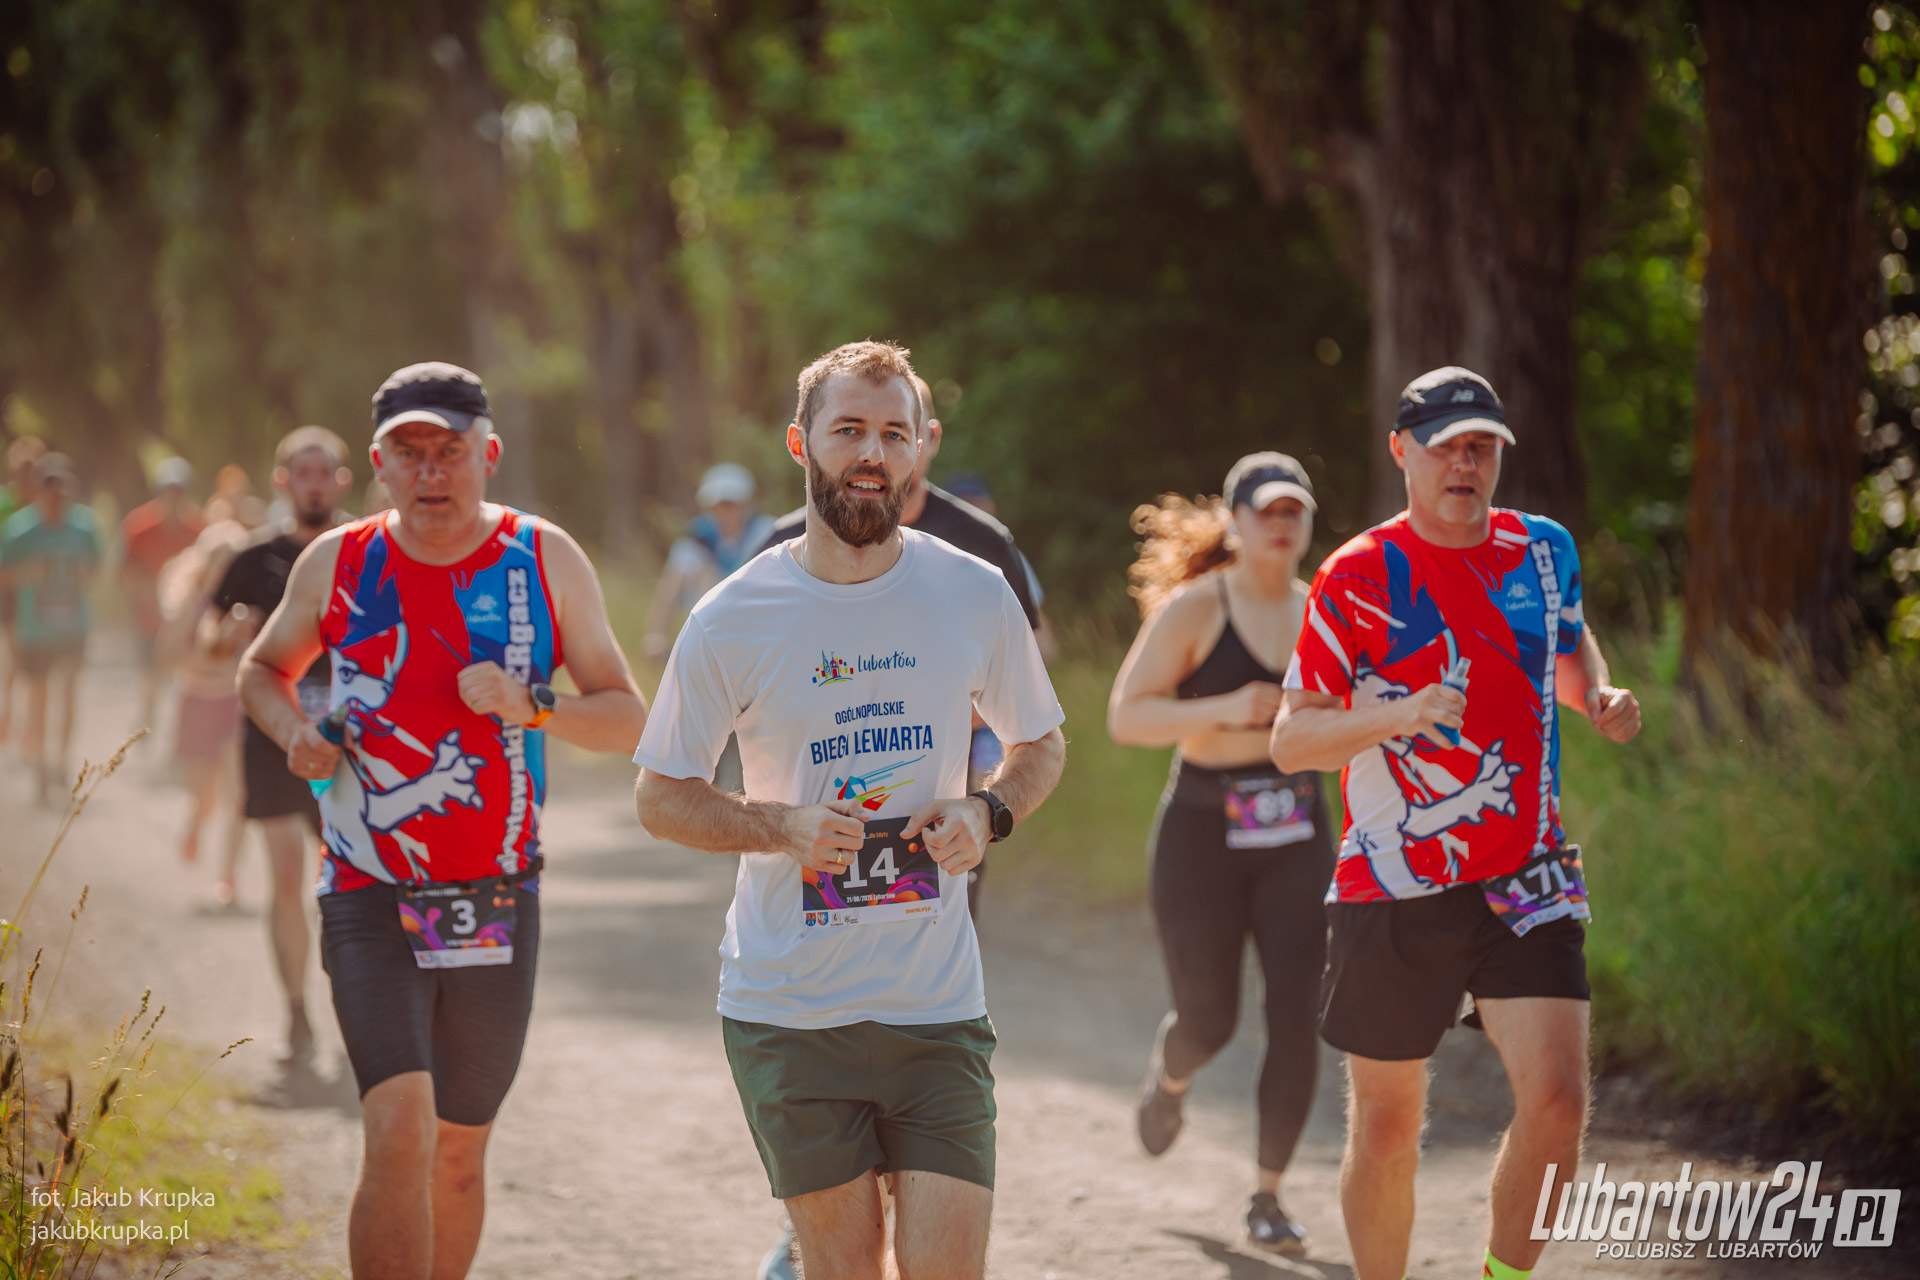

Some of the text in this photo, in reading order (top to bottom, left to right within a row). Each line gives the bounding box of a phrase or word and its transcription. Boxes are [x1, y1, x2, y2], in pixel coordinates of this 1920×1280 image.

[857, 651, 916, 673] Lubartów
[835, 700, 905, 725] OGÓLNOPOLSKIE
[854, 724, 933, 755] LEWARTA
[843, 847, 900, 889] 14
[1506, 860, 1575, 906] 171
[451, 900, 477, 935] 3
